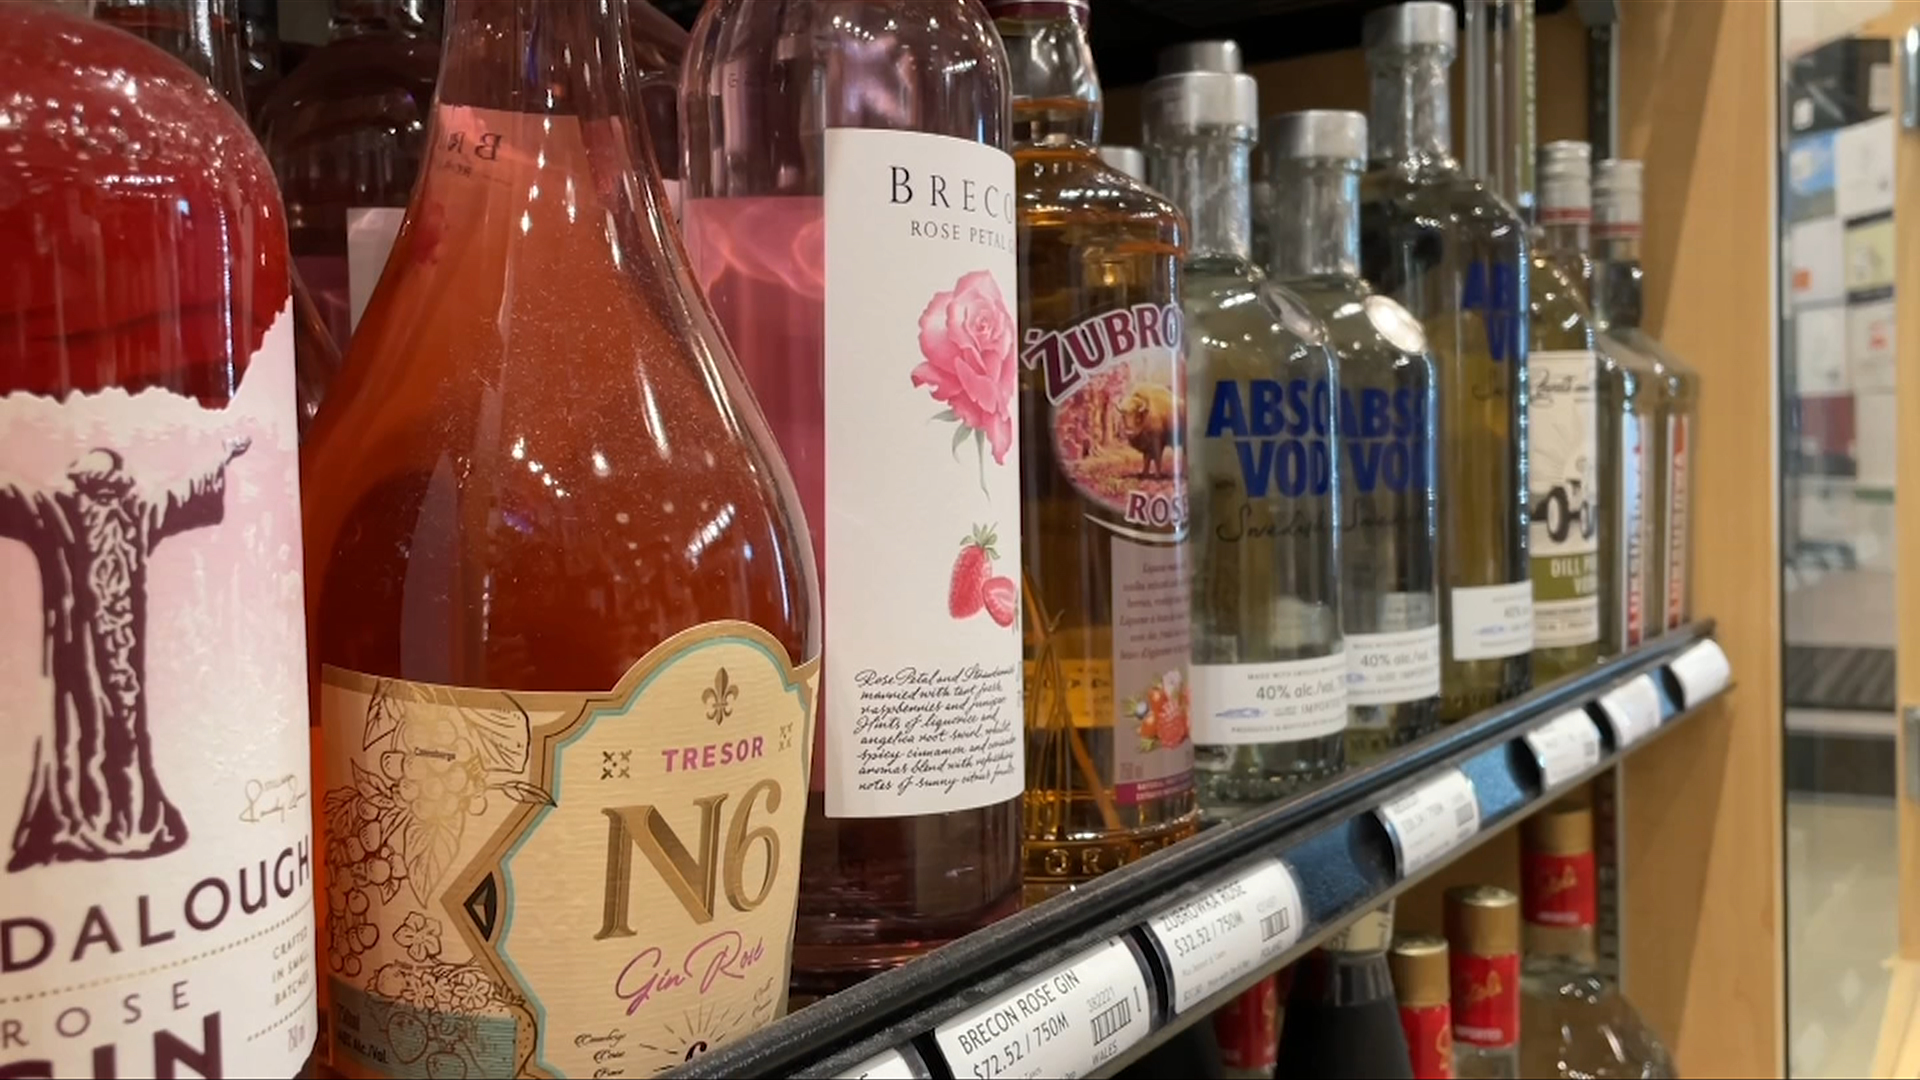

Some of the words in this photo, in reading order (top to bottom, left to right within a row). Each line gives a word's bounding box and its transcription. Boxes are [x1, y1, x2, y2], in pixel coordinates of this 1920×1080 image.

[910, 220, 960, 240] ROSE
[969, 226, 1006, 250] PETAL
[1360, 653, 1391, 667] 40%
[854, 669, 894, 688] Rose
[895, 667, 940, 686] Petal
[920, 686, 949, 698] with
[945, 696, 971, 710] and
[1256, 684, 1291, 701] 40%
[904, 714, 922, 734] of
[980, 706, 1001, 721] and
[661, 735, 765, 773] TRESOR
[968, 736, 990, 754] and
[910, 758, 949, 774] blend
[946, 754, 973, 770] with
[858, 779, 892, 791] notes
[897, 775, 914, 796] of
[593, 777, 783, 942] N6
[1174, 927, 1211, 957] $32.52
[271, 966, 285, 984] IN
[614, 946, 686, 1017] Gin
[2, 980, 191, 1050] ROSE
[958, 1005, 1020, 1056] BRECON
[1017, 985, 1057, 1019] ROSE
[1053, 969, 1081, 995] GIN
[973, 1040, 1024, 1080] $72.52
[1032, 1011, 1070, 1047] 750M
[1091, 1039, 1118, 1066] WALES
